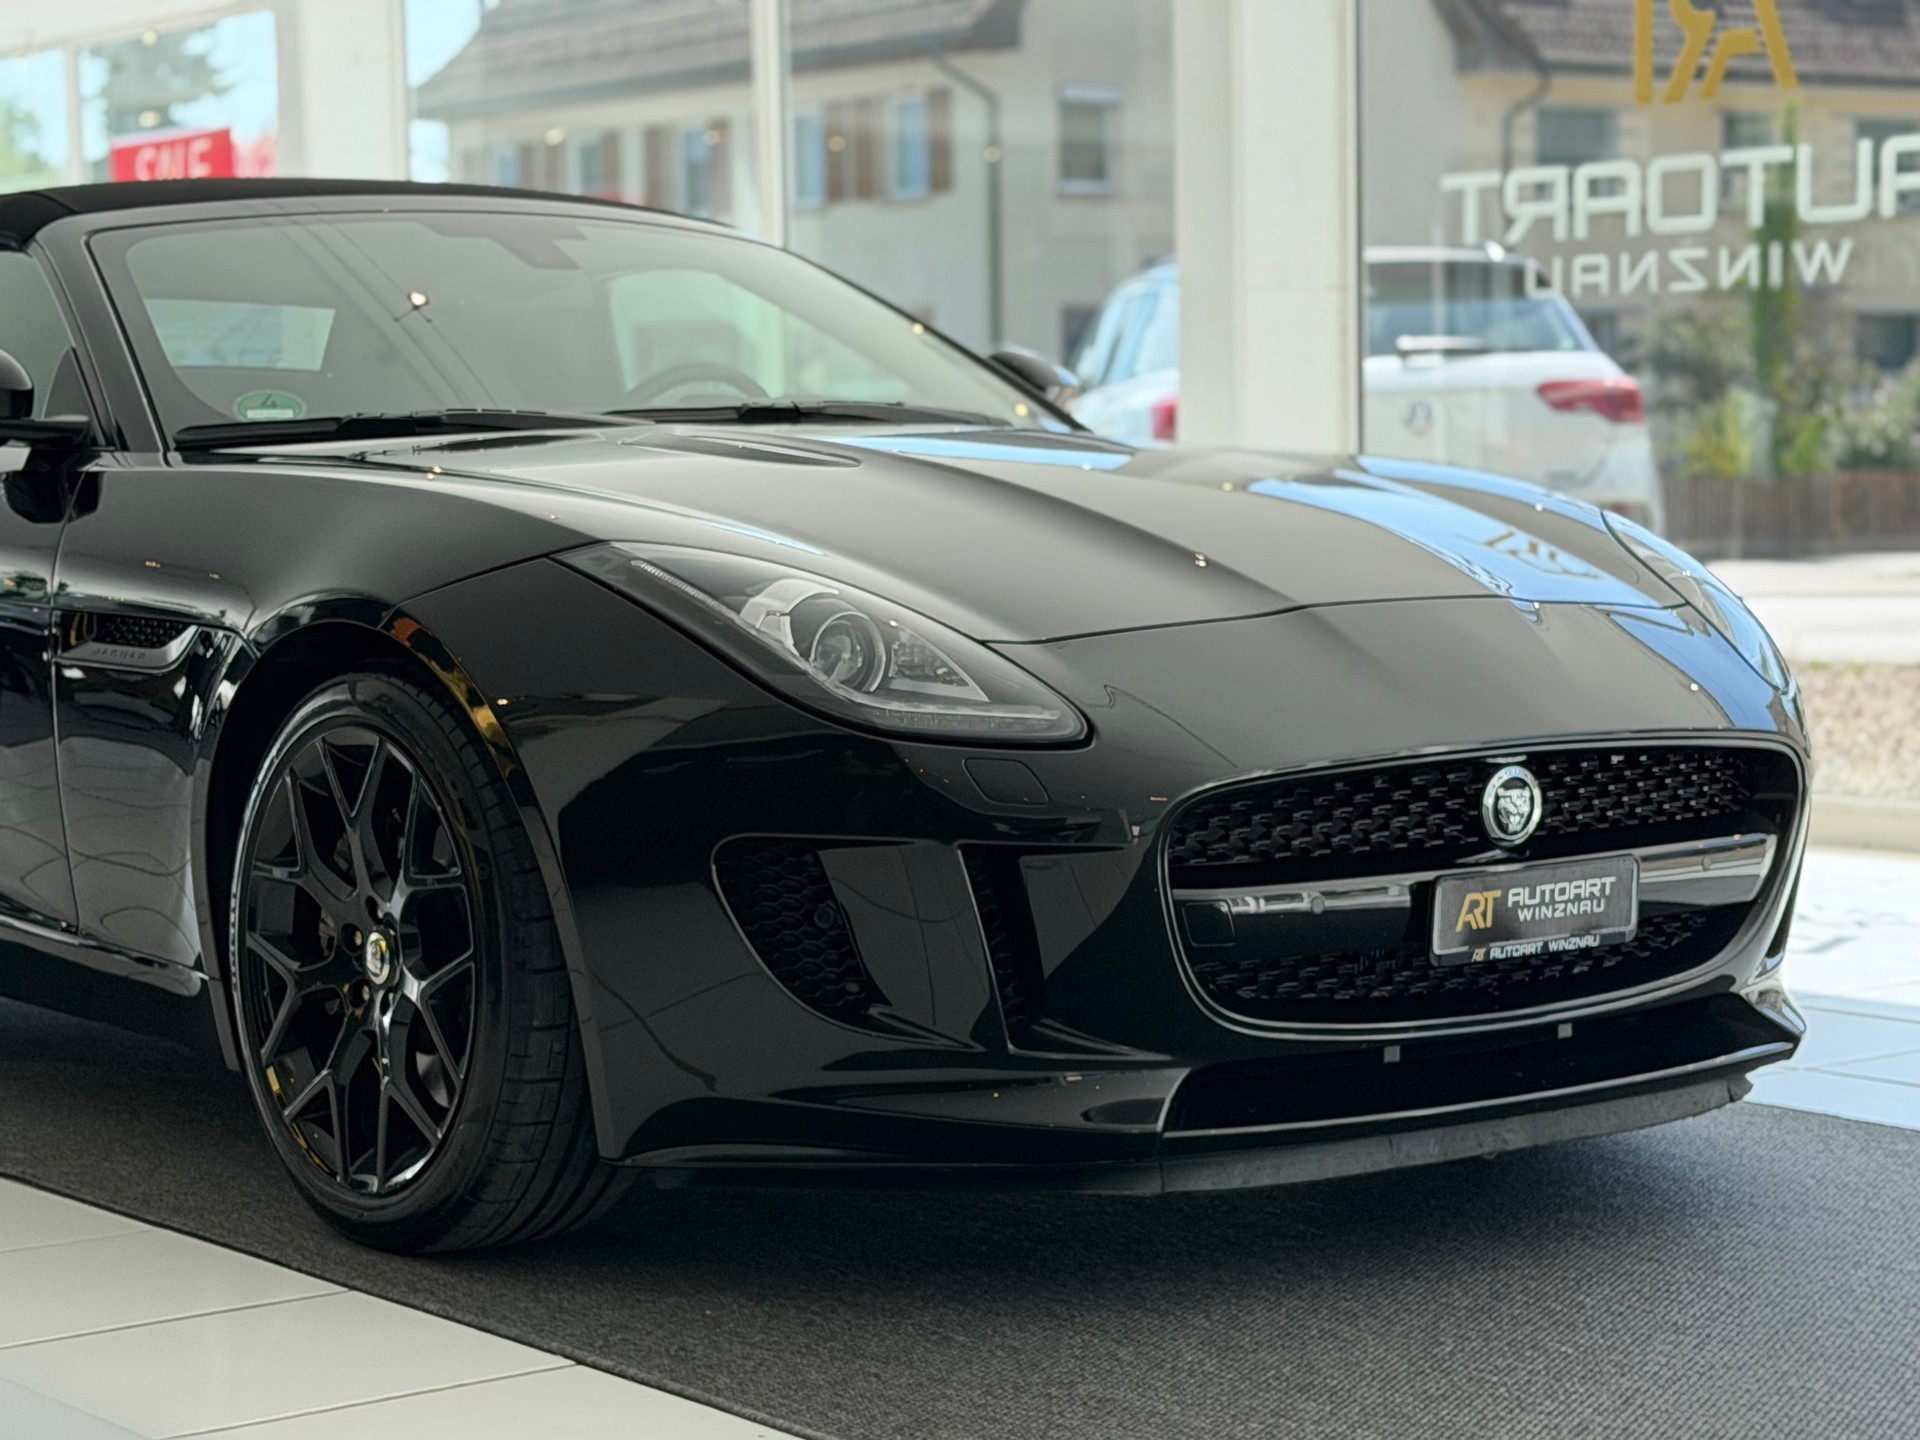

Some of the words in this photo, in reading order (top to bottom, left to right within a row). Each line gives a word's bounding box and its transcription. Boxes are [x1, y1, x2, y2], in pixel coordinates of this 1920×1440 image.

[1508, 877, 1617, 908] AUTOART
[1518, 899, 1605, 922] WINZNAU
[1490, 942, 1544, 960] AUTOART
[1548, 935, 1600, 952] WINZNAU
